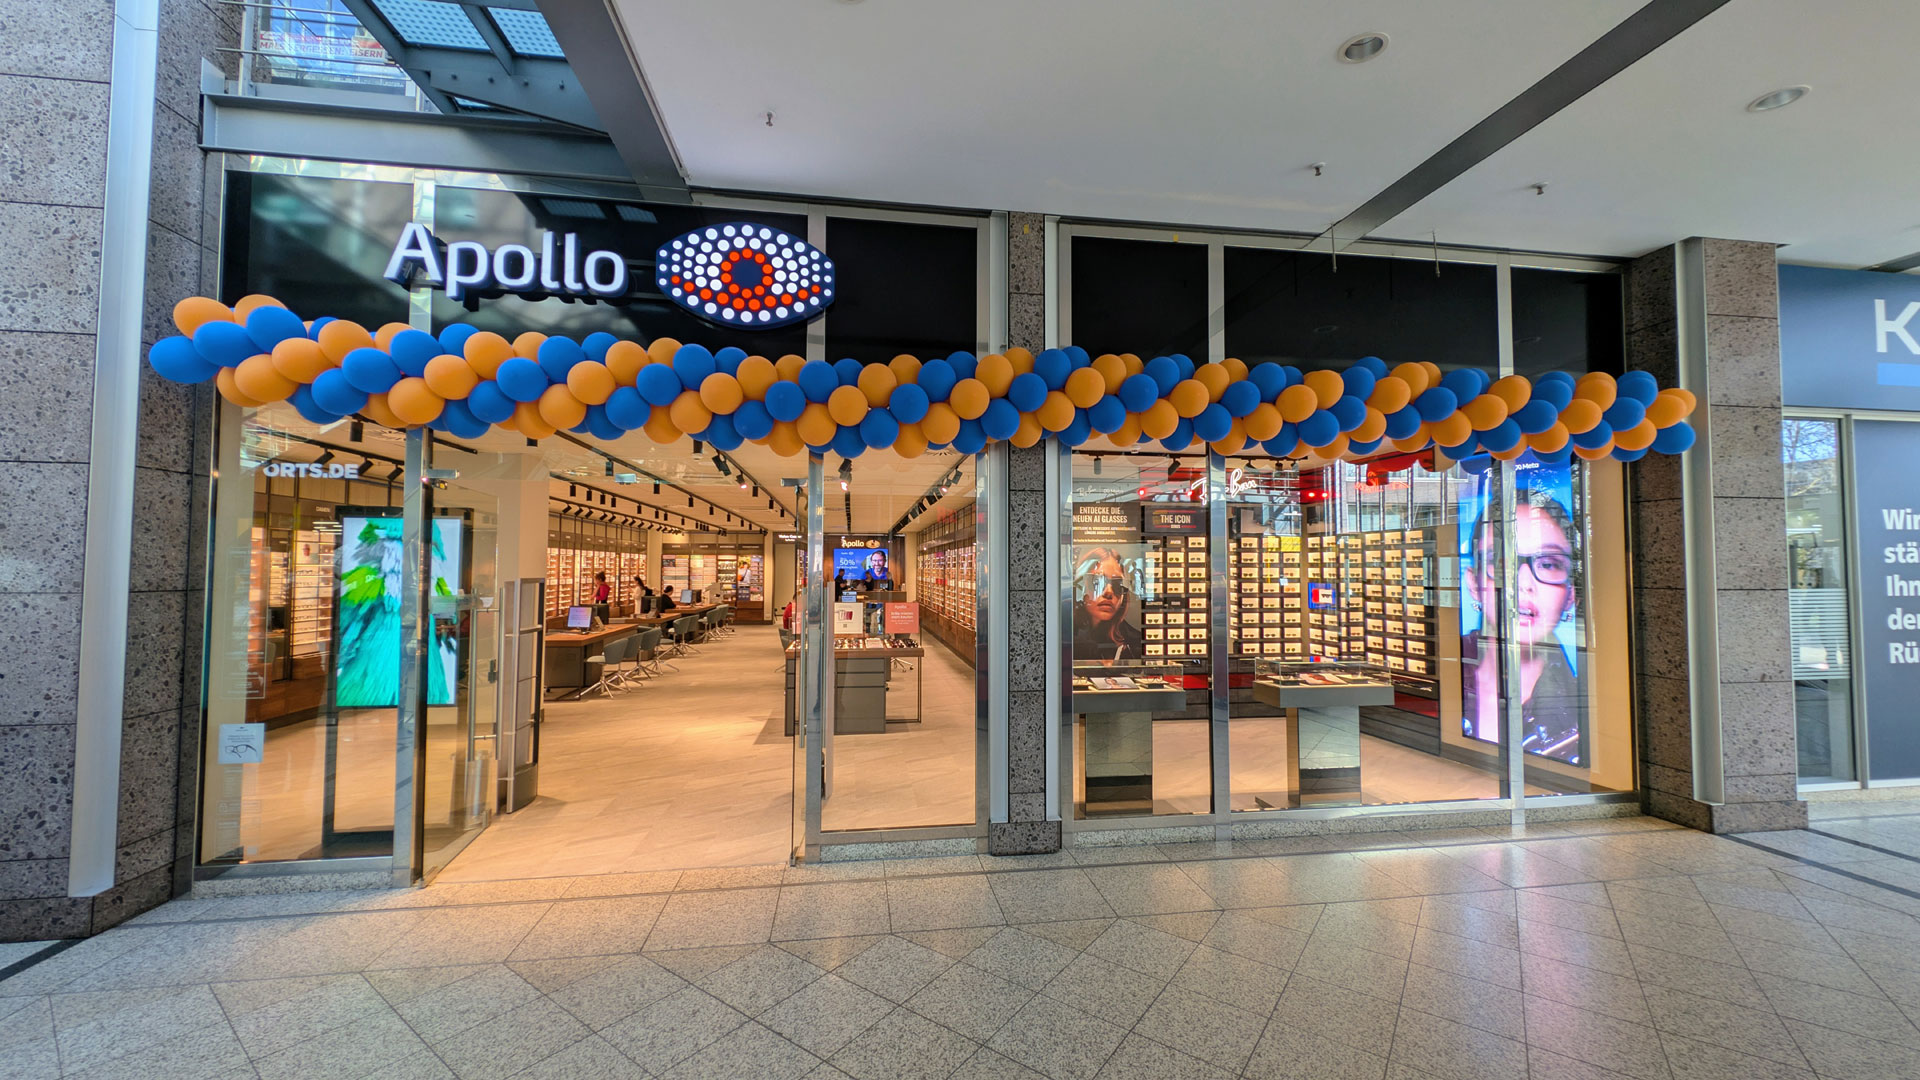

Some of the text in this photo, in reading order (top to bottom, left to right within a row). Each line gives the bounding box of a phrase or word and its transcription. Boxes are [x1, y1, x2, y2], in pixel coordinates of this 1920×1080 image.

[351, 48, 384, 58] EISERN
[384, 222, 628, 299] Apollo
[1874, 298, 1920, 355] K
[1079, 506, 1121, 515] ENTDECKE DIE
[1073, 515, 1128, 523] NEUEN AI GLASSES
[1160, 514, 1191, 523] THE ICON
[842, 540, 865, 548] Apollo
[1884, 542, 1920, 564] stä
[1889, 641, 1920, 664] Rü
